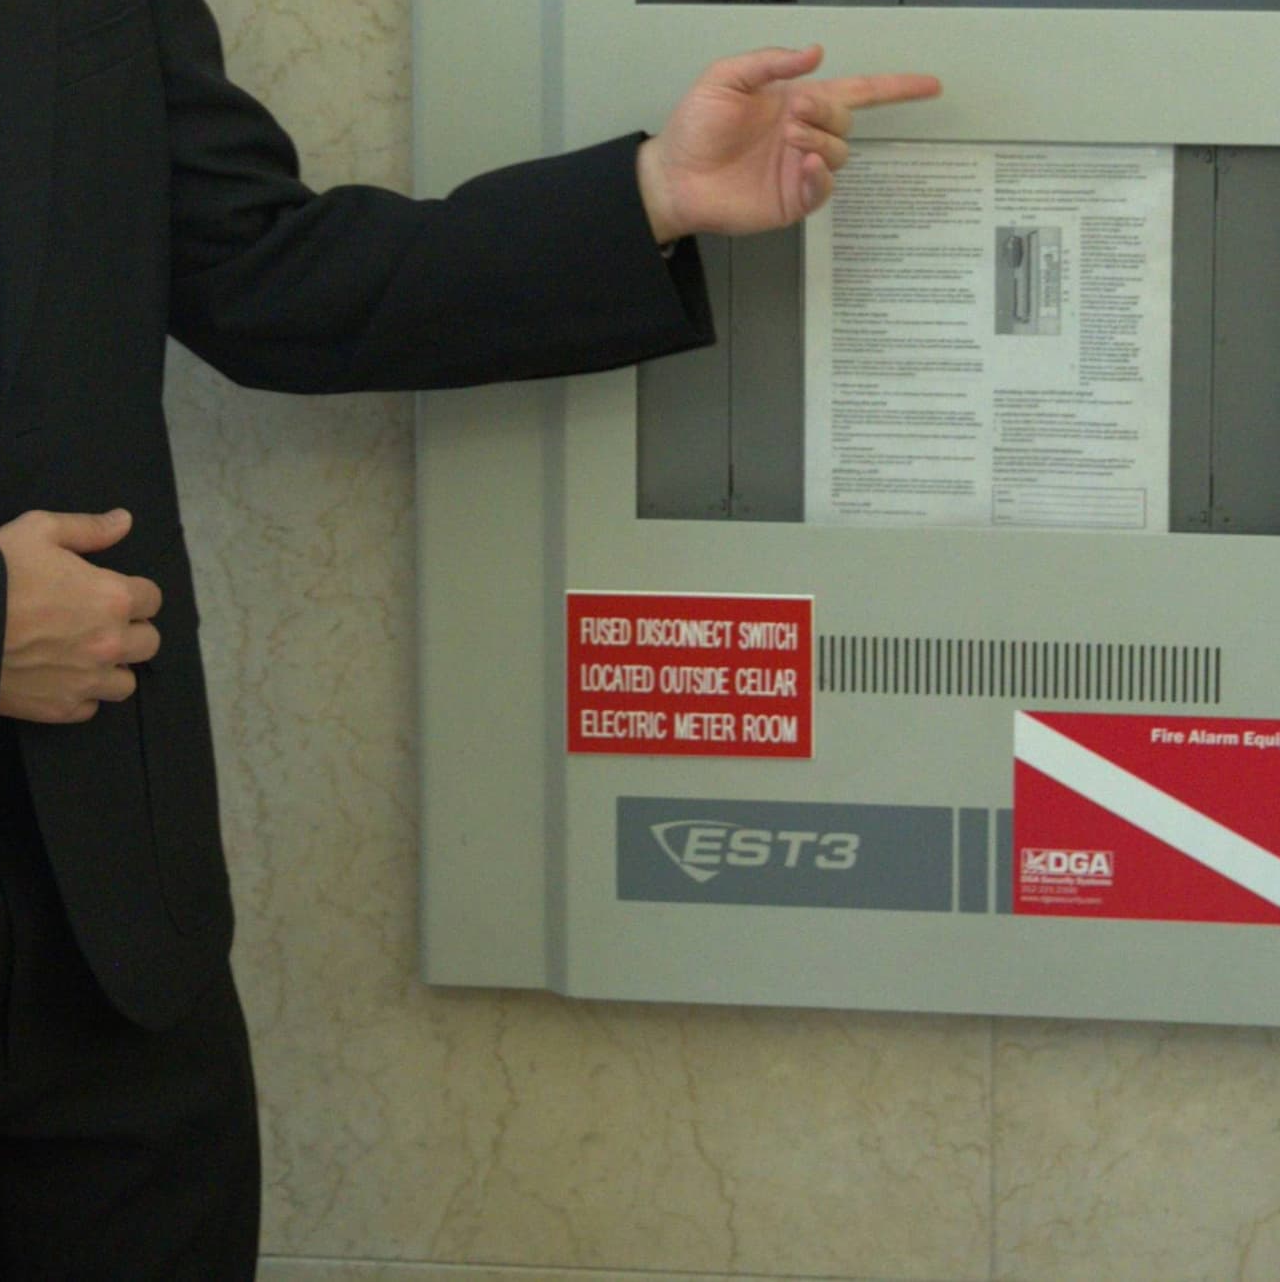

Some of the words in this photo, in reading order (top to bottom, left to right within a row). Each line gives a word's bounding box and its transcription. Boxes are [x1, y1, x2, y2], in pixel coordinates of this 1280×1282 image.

[581, 617, 631, 646] FUSED
[636, 618, 733, 649] DISCONNECT
[738, 621, 798, 650] SWITCH
[581, 663, 655, 693] LOCATED
[660, 666, 730, 695] OUTSIDE
[735, 668, 798, 697] CELLAR
[581, 709, 667, 740] ELECTRIC
[674, 712, 736, 742] METER
[742, 714, 798, 743] ROOM
[1150, 727, 1184, 745] Fire
[1188, 729, 1239, 746] Alarm
[683, 827, 861, 870] EST3
